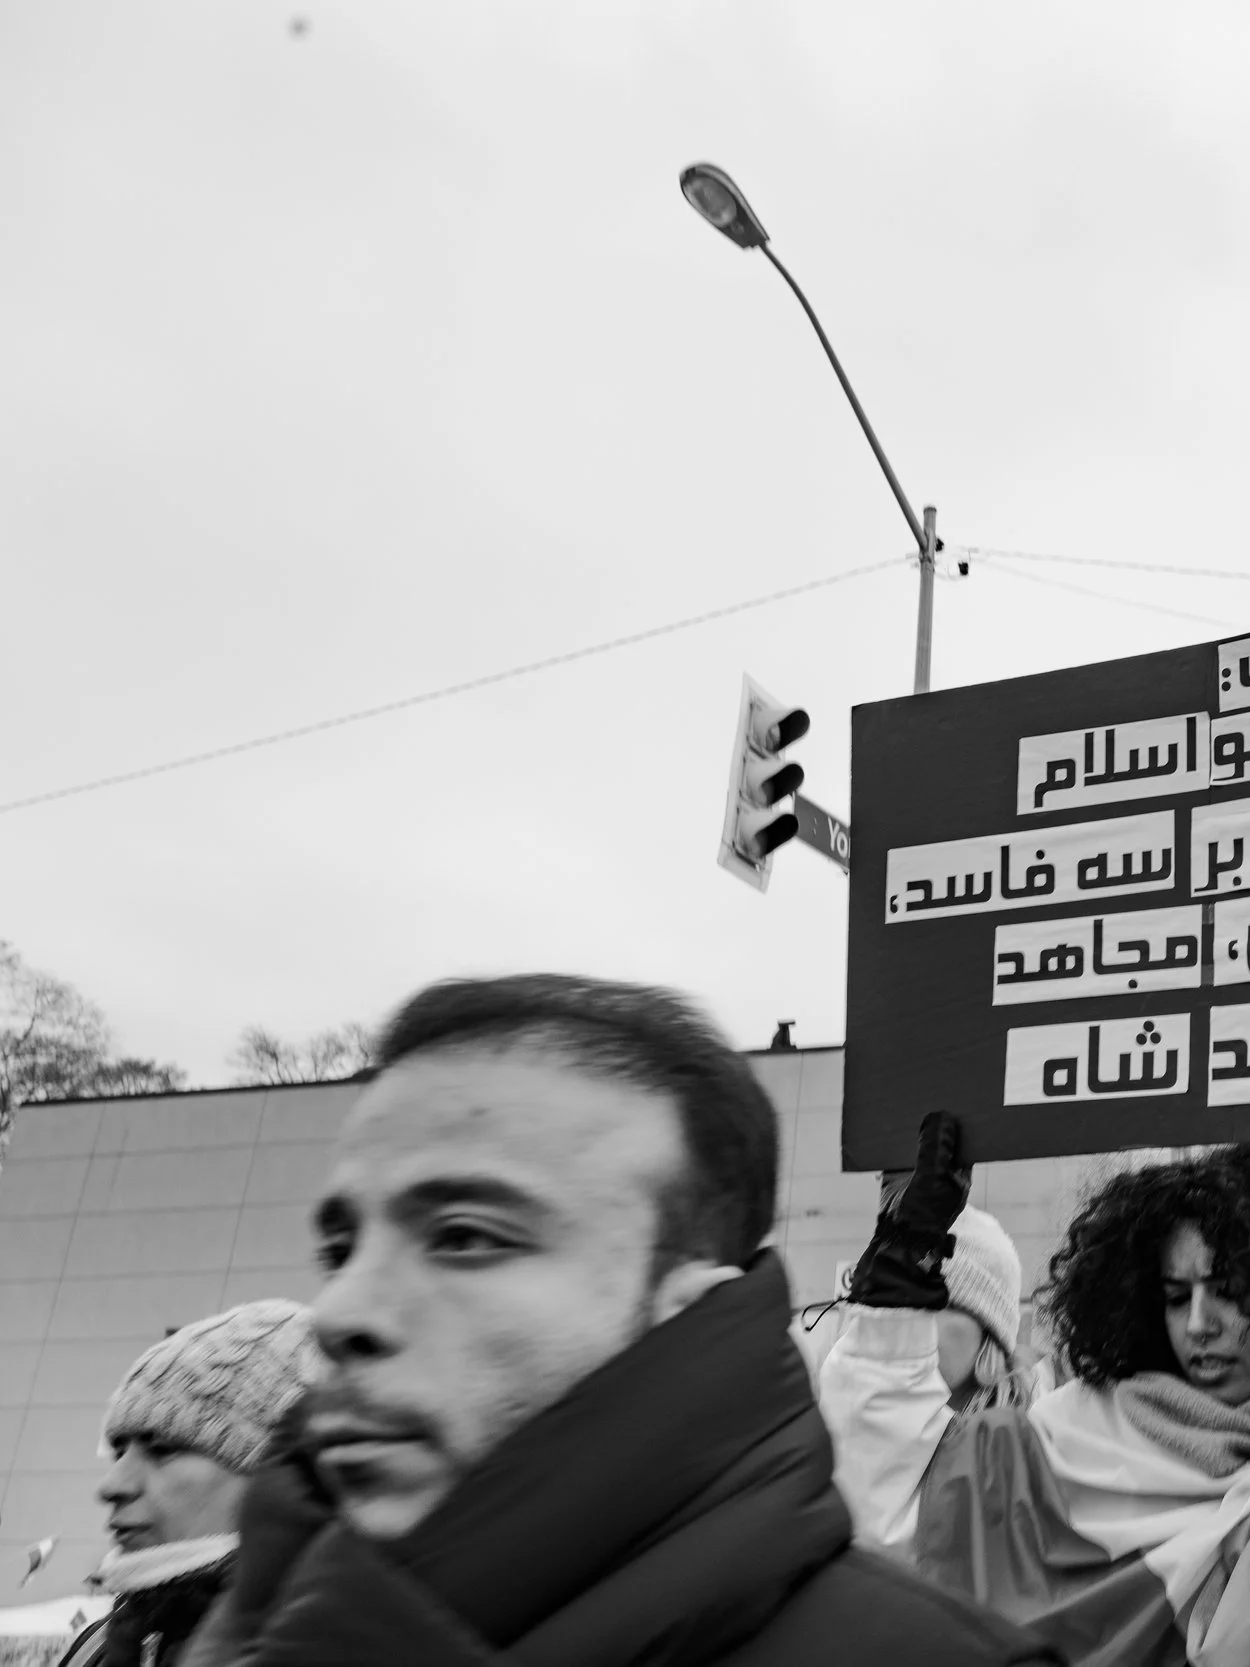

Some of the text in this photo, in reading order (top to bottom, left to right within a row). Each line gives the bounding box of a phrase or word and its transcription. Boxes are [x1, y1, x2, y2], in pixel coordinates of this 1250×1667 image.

[1034, 716, 1196, 808] اسلام
[828, 817, 850, 859] Yo
[1078, 848, 1171, 890] سه
[1194, 838, 1243, 892] بر
[890, 845, 1055, 913] فاسد،
[997, 919, 1198, 989] مجاهد
[1043, 1021, 1178, 1096] شاه
